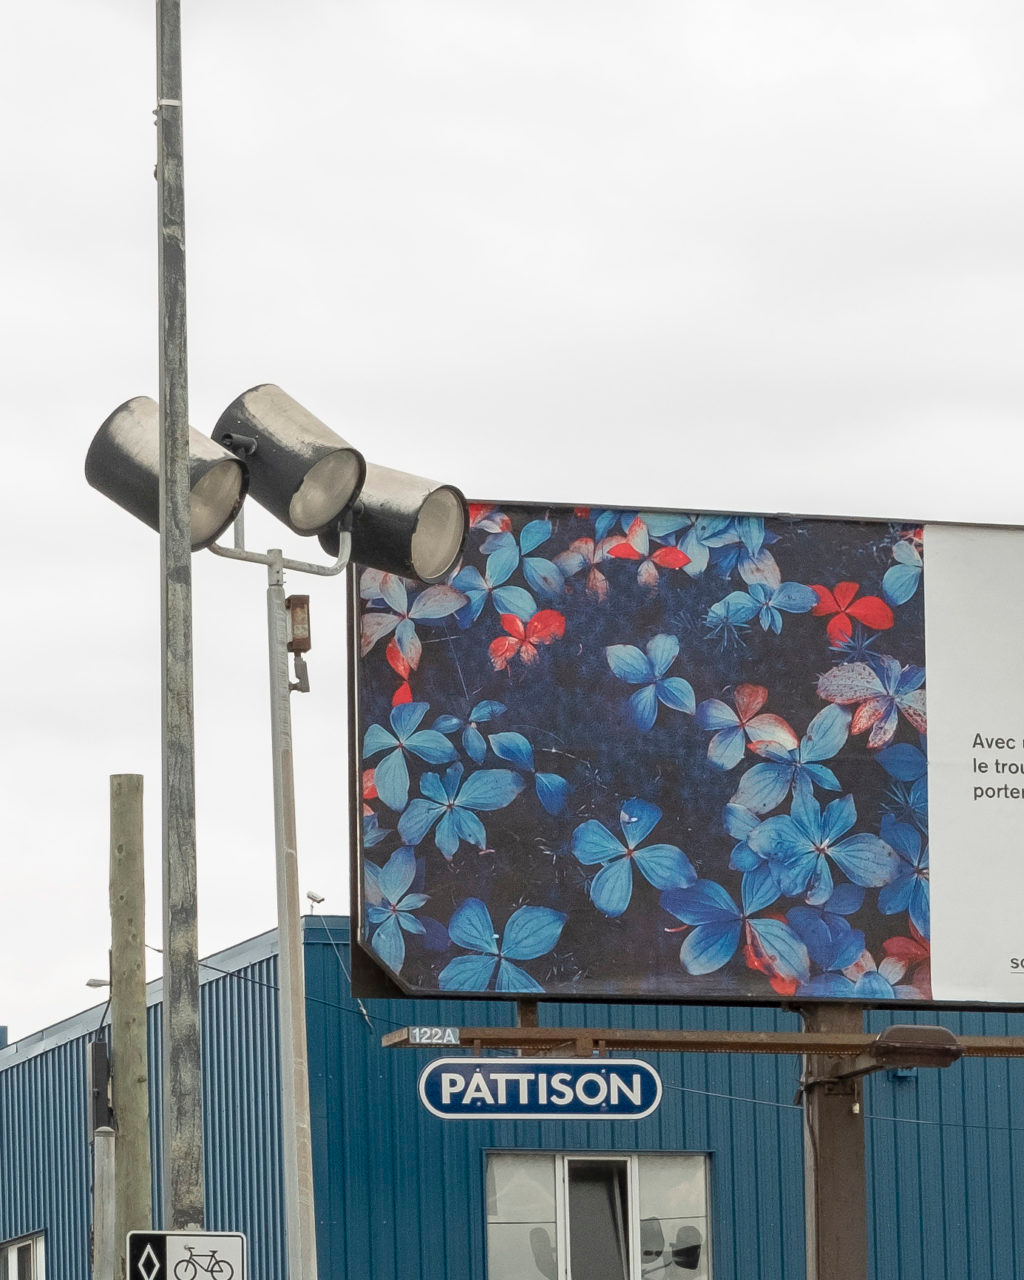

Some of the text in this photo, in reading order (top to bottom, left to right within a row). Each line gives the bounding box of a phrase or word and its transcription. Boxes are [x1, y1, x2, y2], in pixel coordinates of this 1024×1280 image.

[972, 733, 1016, 750] Avec
[973, 758, 988, 773] le
[411, 1028, 456, 1043] 122A
[441, 1072, 642, 1106] PATTISON
